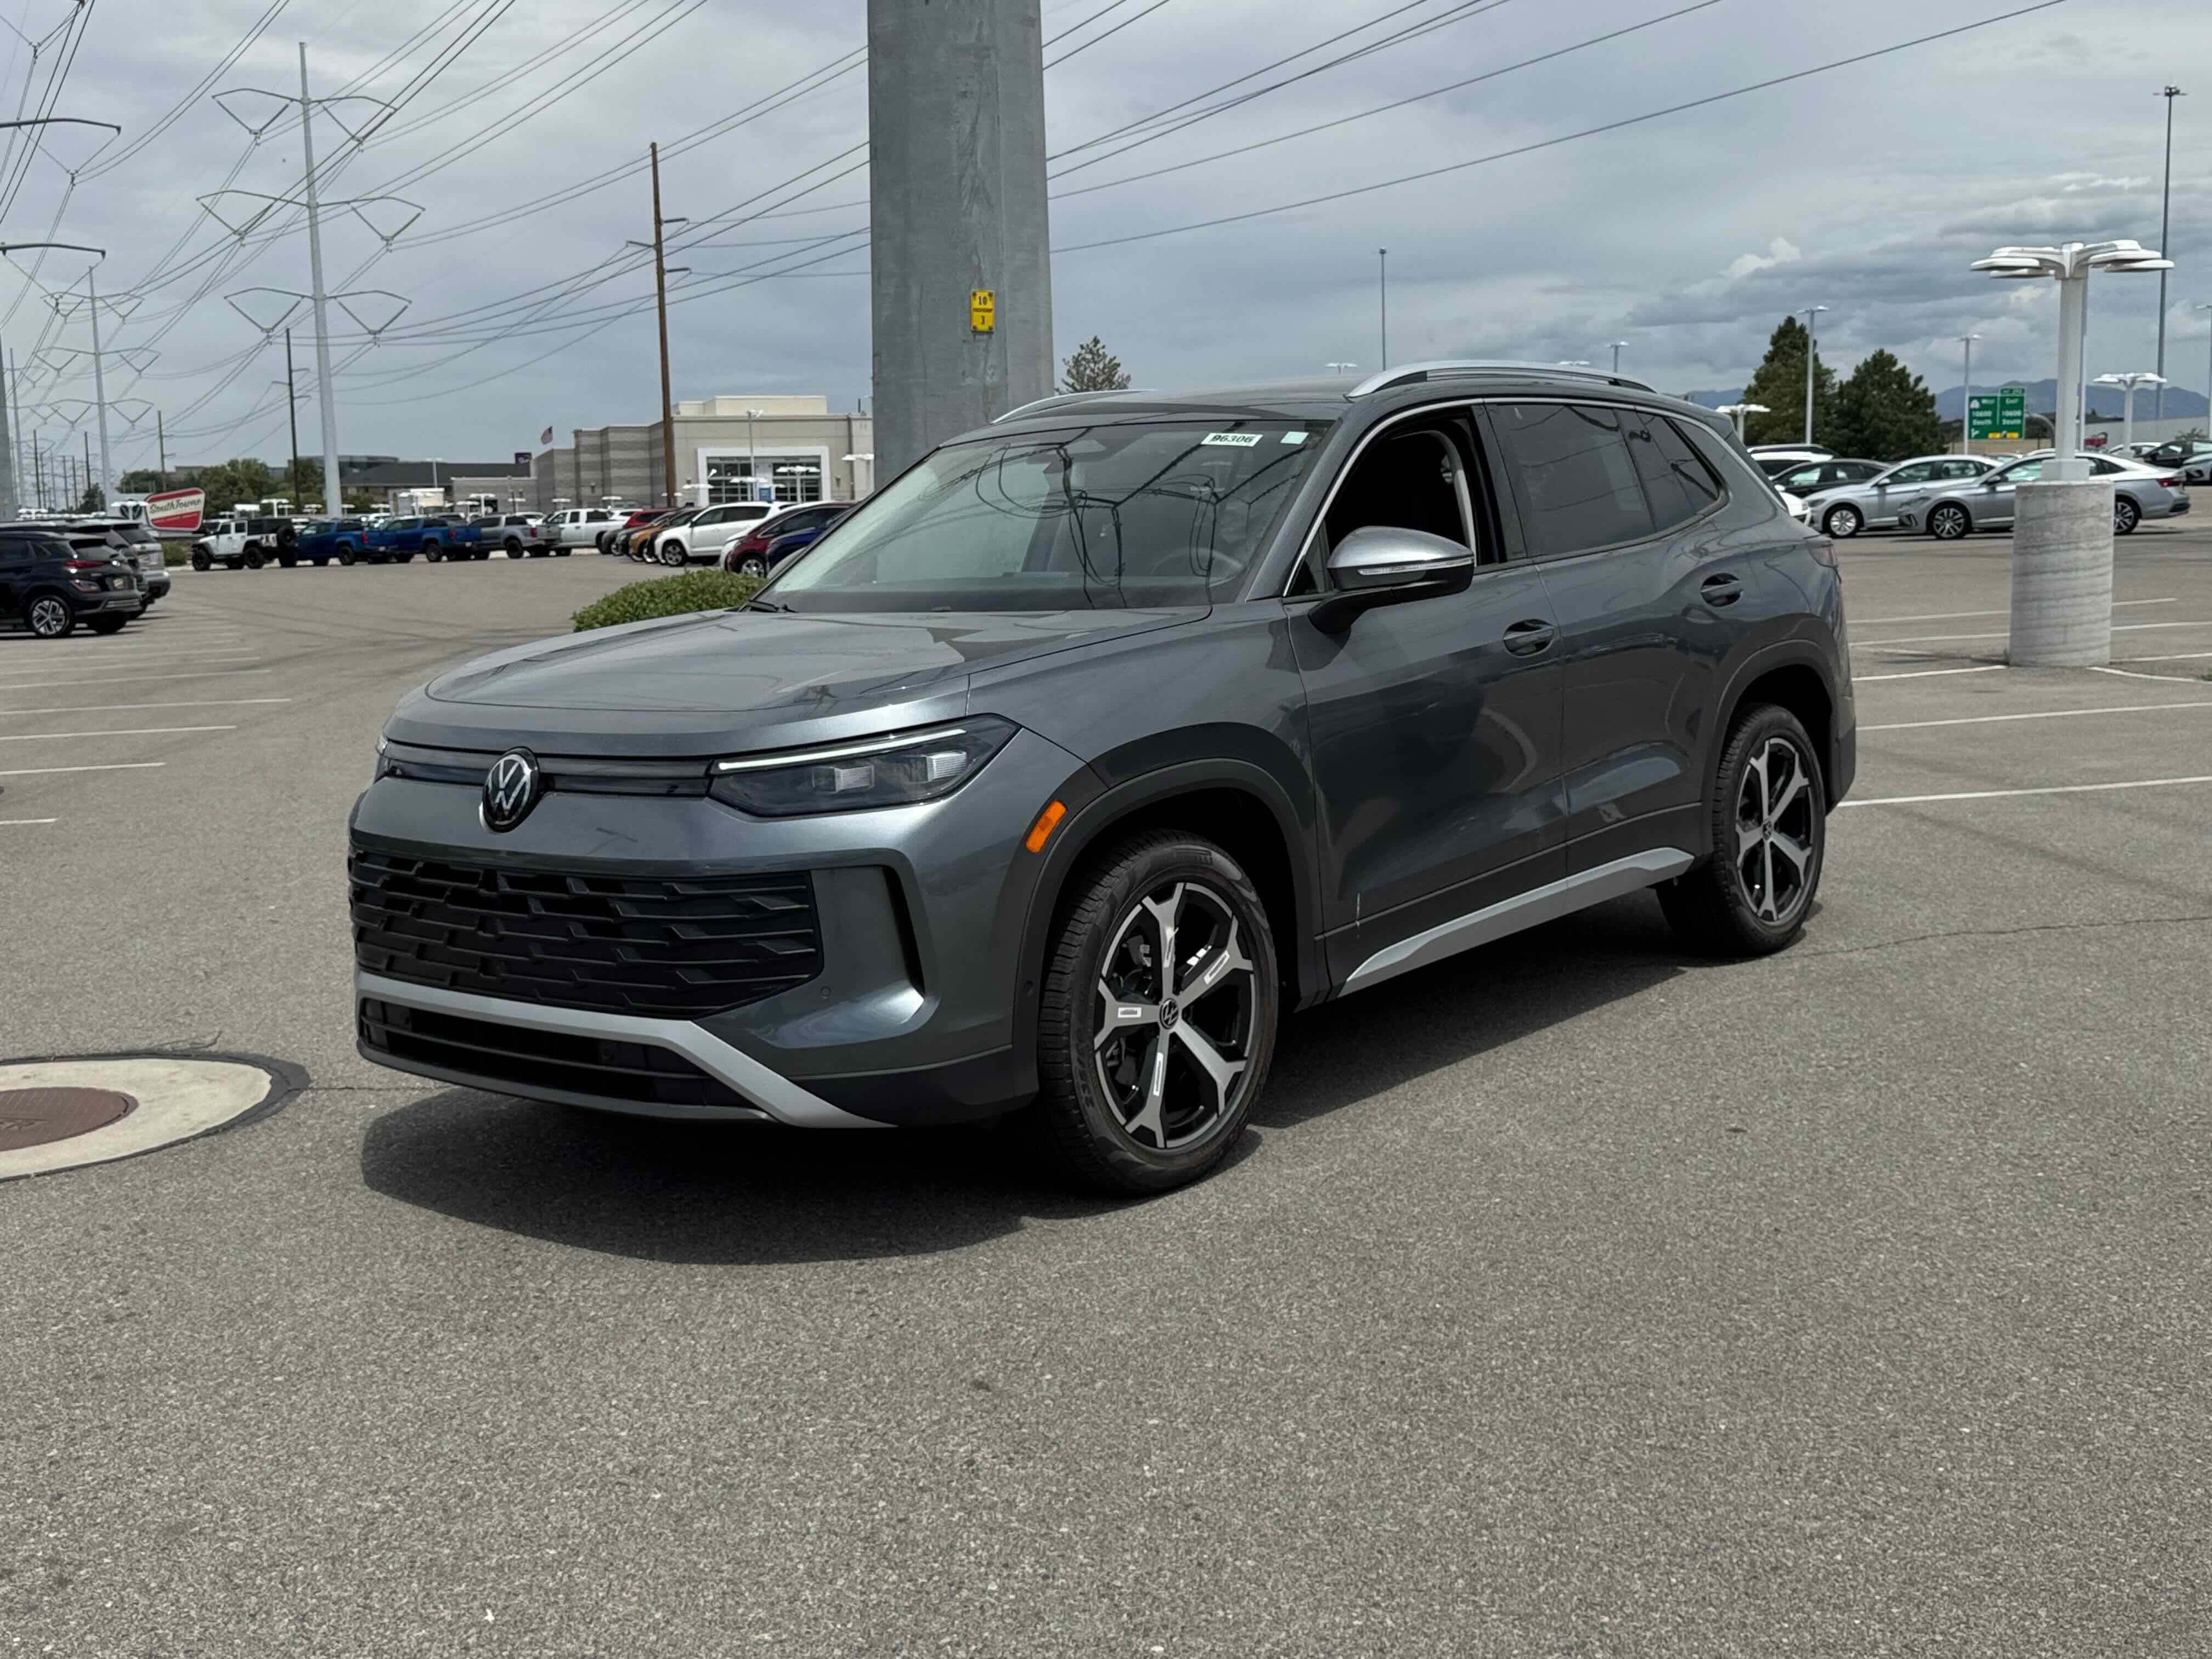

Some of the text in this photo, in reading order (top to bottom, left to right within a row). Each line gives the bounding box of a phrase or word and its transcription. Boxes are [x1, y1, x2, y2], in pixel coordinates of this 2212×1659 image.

[979, 296, 988, 305] 10
[980, 316, 985, 325] 3
[1210, 435, 1256, 443] 96306
